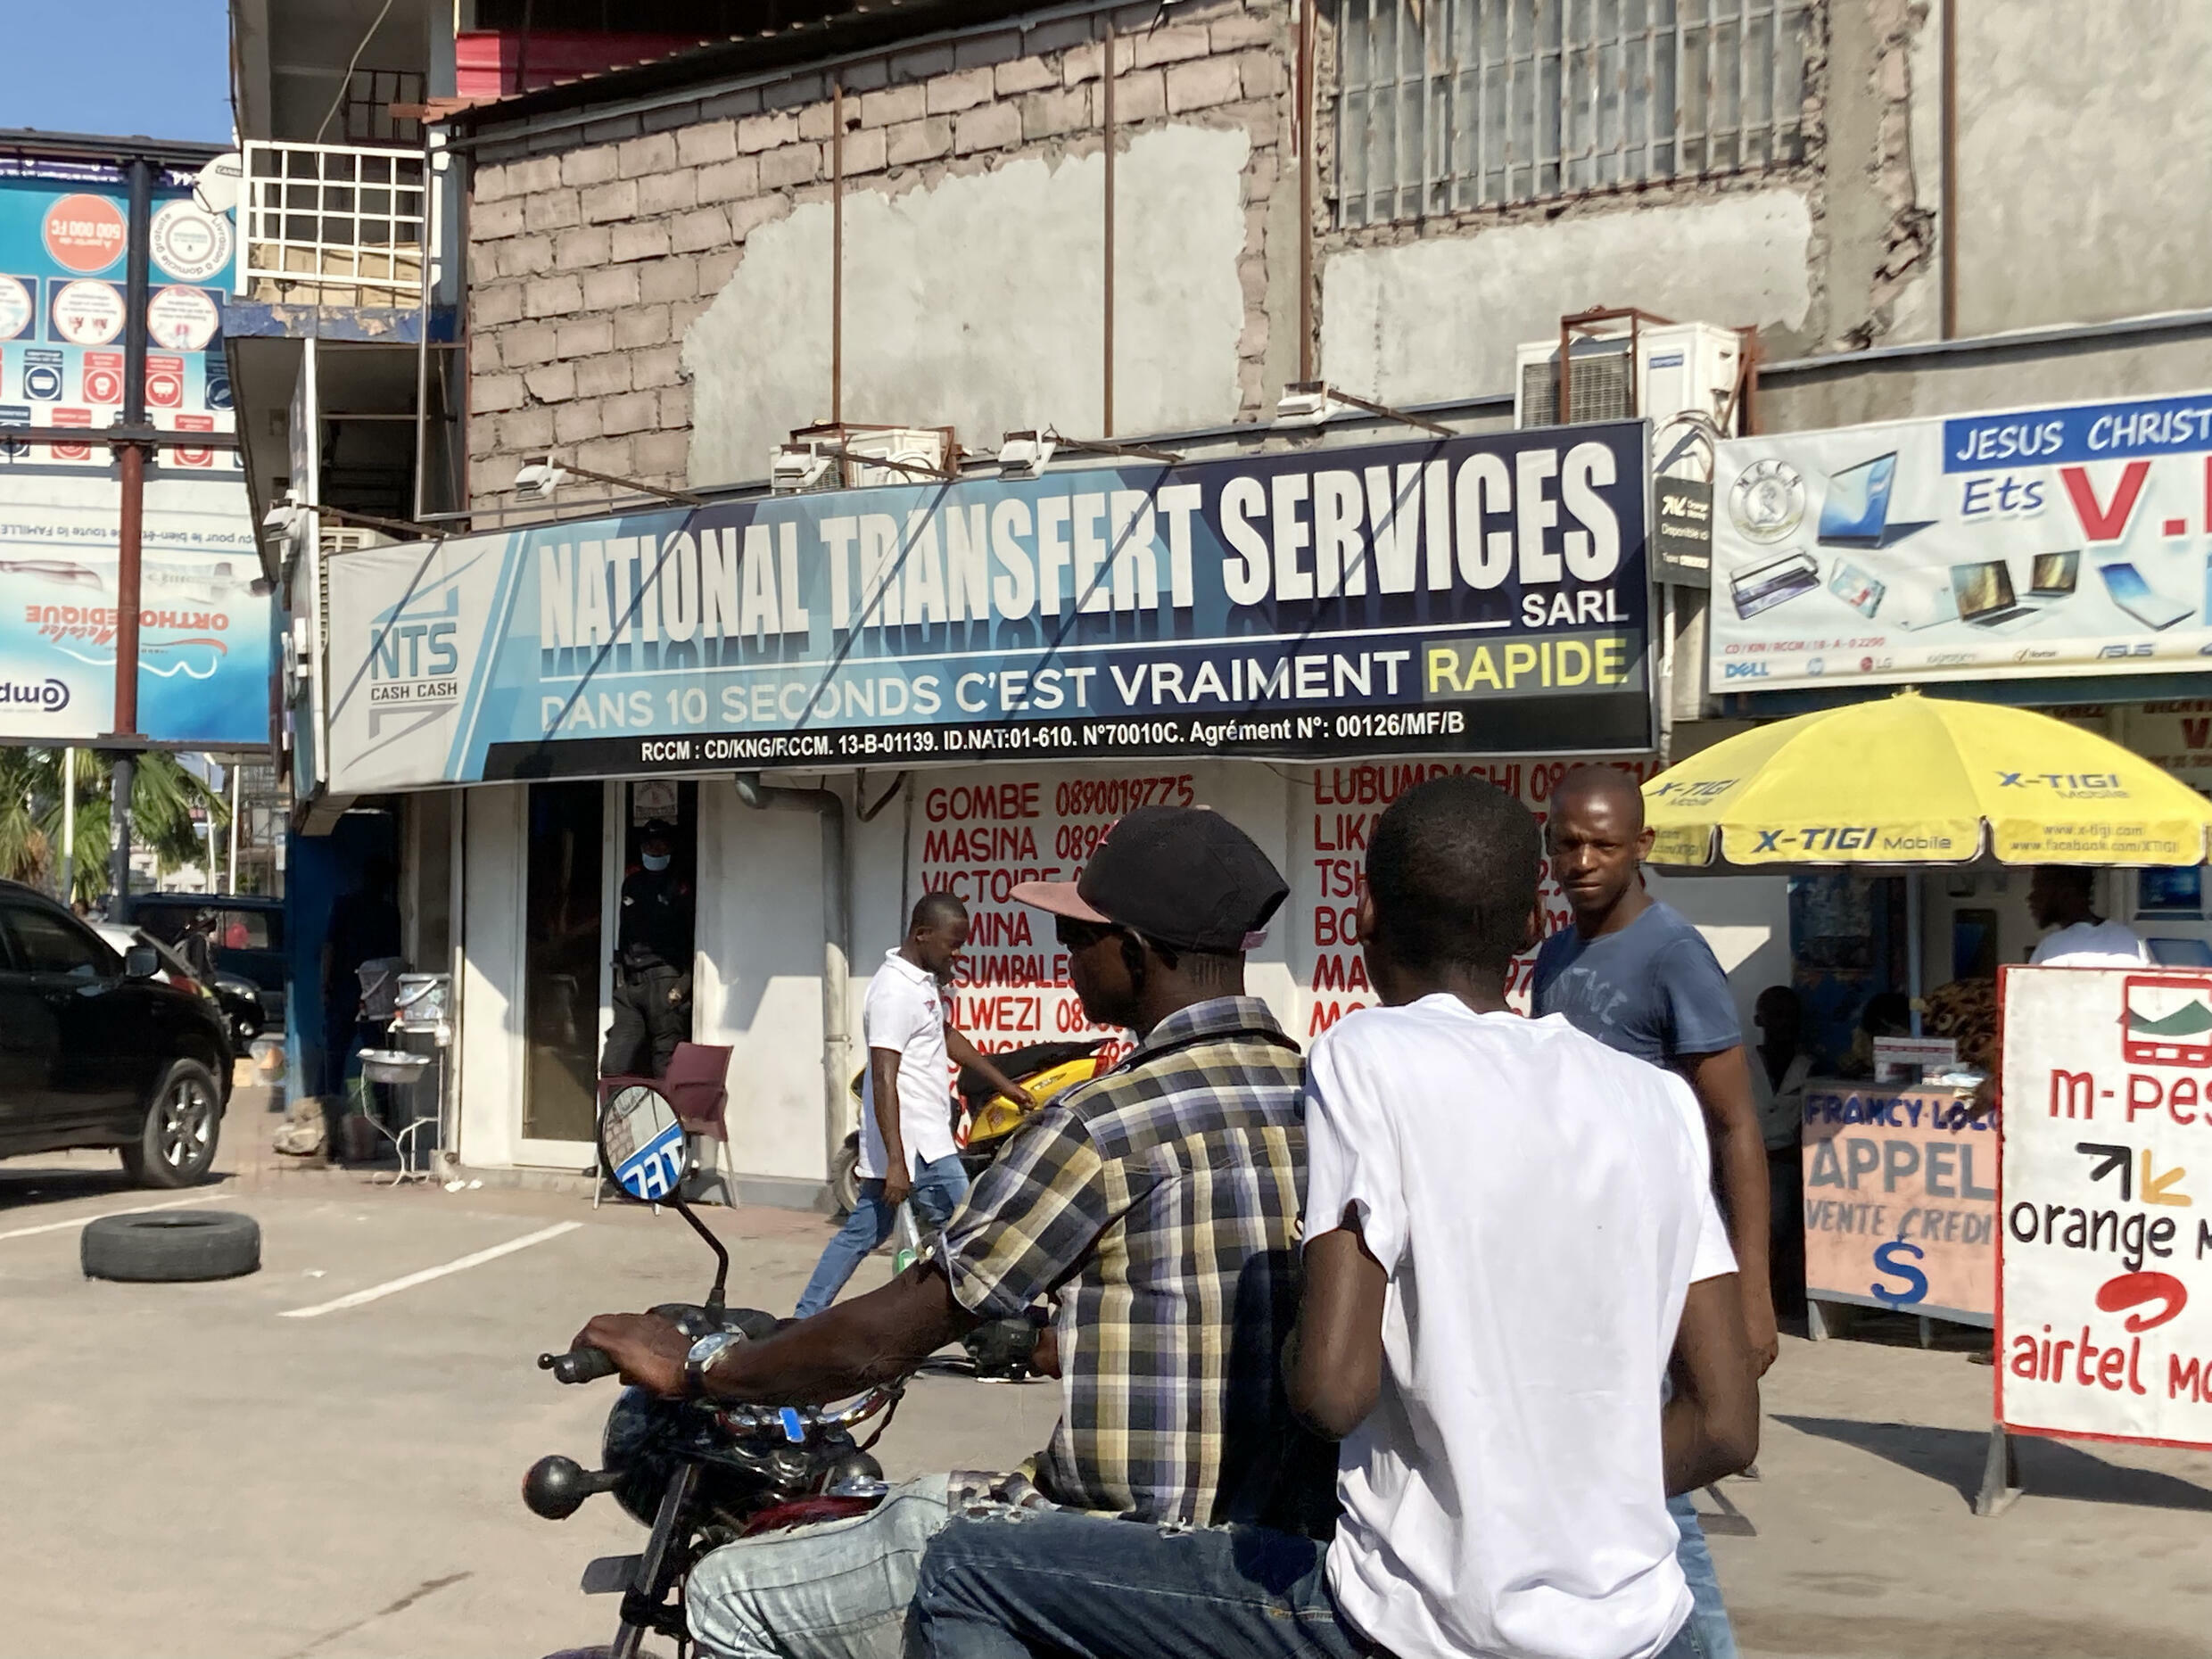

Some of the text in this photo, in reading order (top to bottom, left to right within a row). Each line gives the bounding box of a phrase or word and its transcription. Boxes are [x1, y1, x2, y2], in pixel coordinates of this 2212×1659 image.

[1956, 421, 2065, 460] JESUS
[1961, 475, 2045, 515] Ets
[1, 524, 54, 538] FAMILLE
[73, 526, 106, 540] toute
[192, 532, 202, 543] le
[206, 532, 235, 544] pour
[538, 442, 1620, 650] NATIONAL TRANSFERT SERVICES
[24, 605, 229, 631] ORTHOEDIQUE
[1522, 588, 1630, 628] SARL
[369, 622, 458, 681] NTS
[2097, 643, 2154, 659] ASUS
[540, 637, 1629, 732] DANS 10 SECONDS C'EST VRAIMENT RAPIDE
[1724, 662, 1770, 678] DELL
[370, 681, 458, 701] CASH CASH
[641, 741, 690, 763] RCCM
[1189, 718, 1292, 748] Agrément
[1335, 710, 1465, 739] 00126/MF/B
[1646, 779, 1737, 797] X-TIGI
[1994, 771, 2120, 789] X-TIGI
[925, 774, 1195, 822] GOMBE 0890019775
[922, 826, 1039, 863] MASINA
[1751, 826, 1952, 854] X-TIGI Mobile
[948, 953, 1076, 988] SUMBALE
[941, 996, 1042, 1031] OLWEZI
[1806, 1199, 1993, 1246] VENTE CREDI
[2009, 1200, 2176, 1273] orange
[2010, 1325, 2147, 1397] airtel
